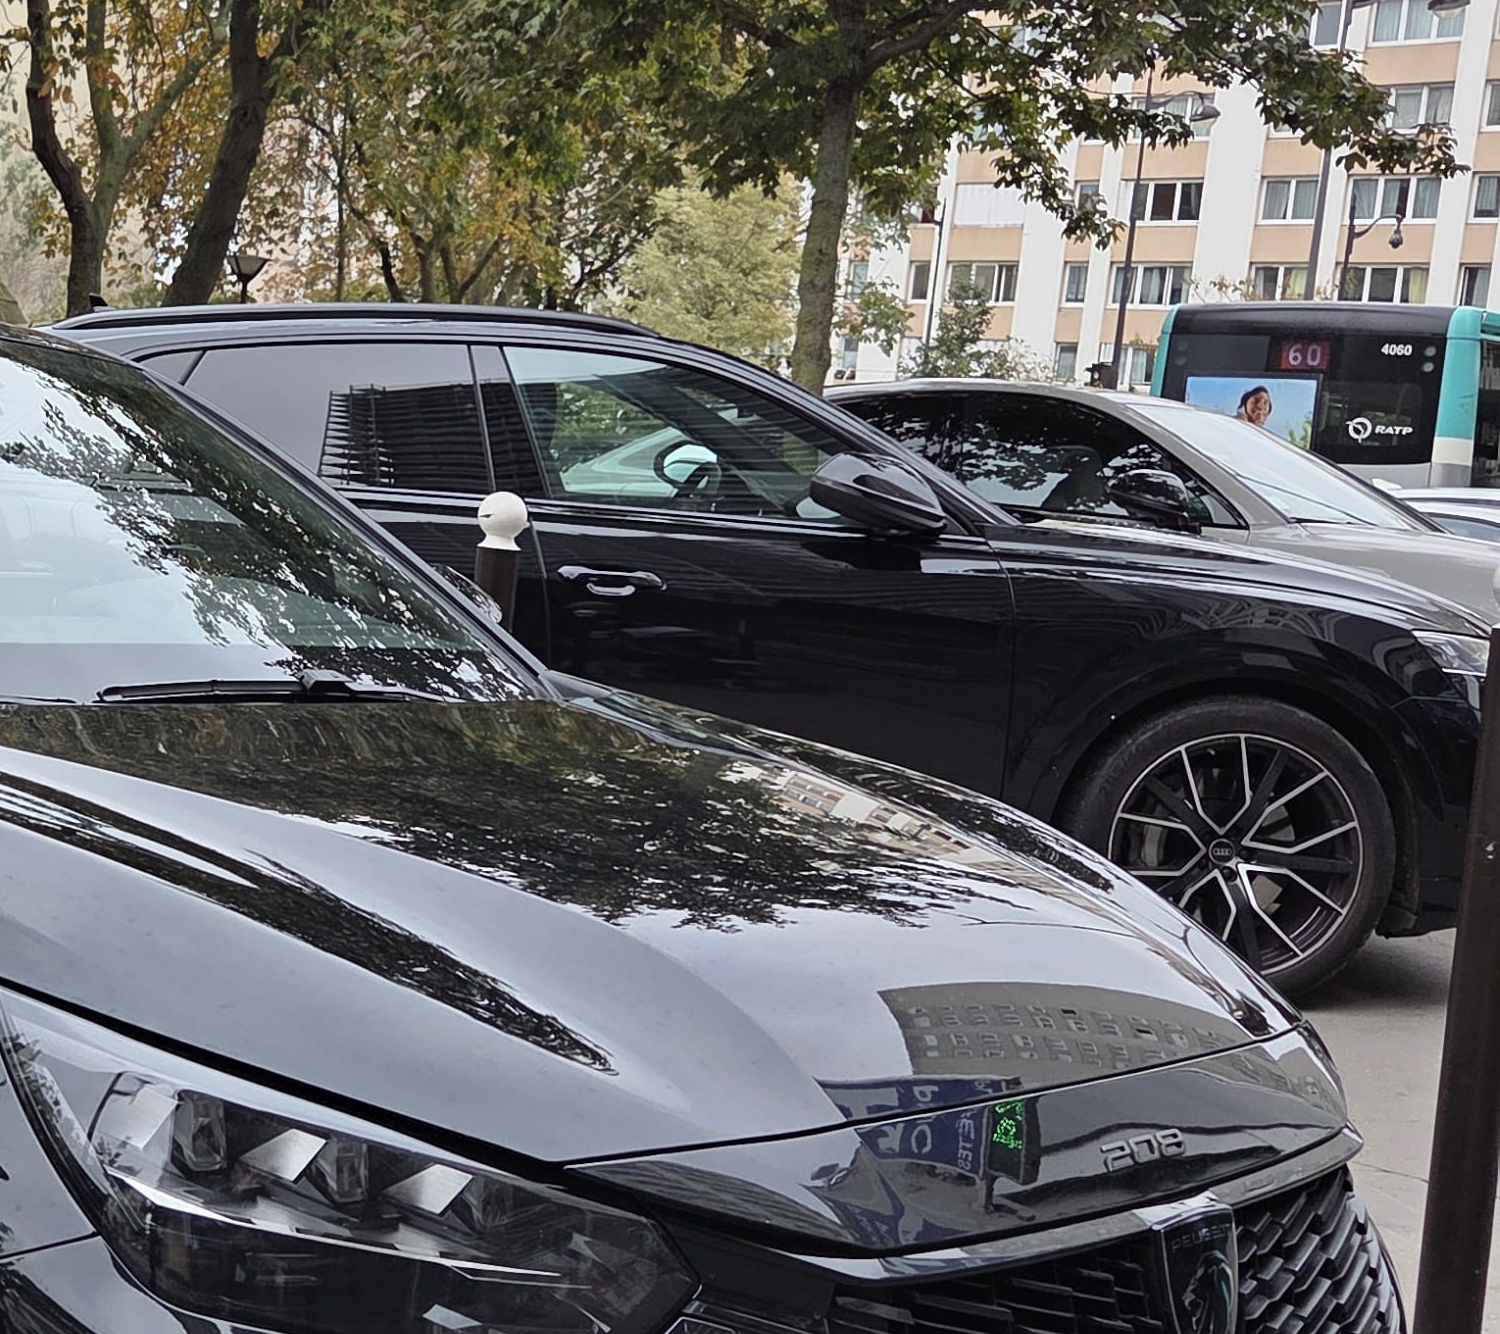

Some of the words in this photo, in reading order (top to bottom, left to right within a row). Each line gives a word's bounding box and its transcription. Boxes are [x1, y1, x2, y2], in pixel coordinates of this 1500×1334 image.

[1288, 344, 1321, 365] 60
[1380, 343, 1413, 355] 4060
[1374, 425, 1414, 435] RATP
[1100, 1128, 1188, 1172] 208
